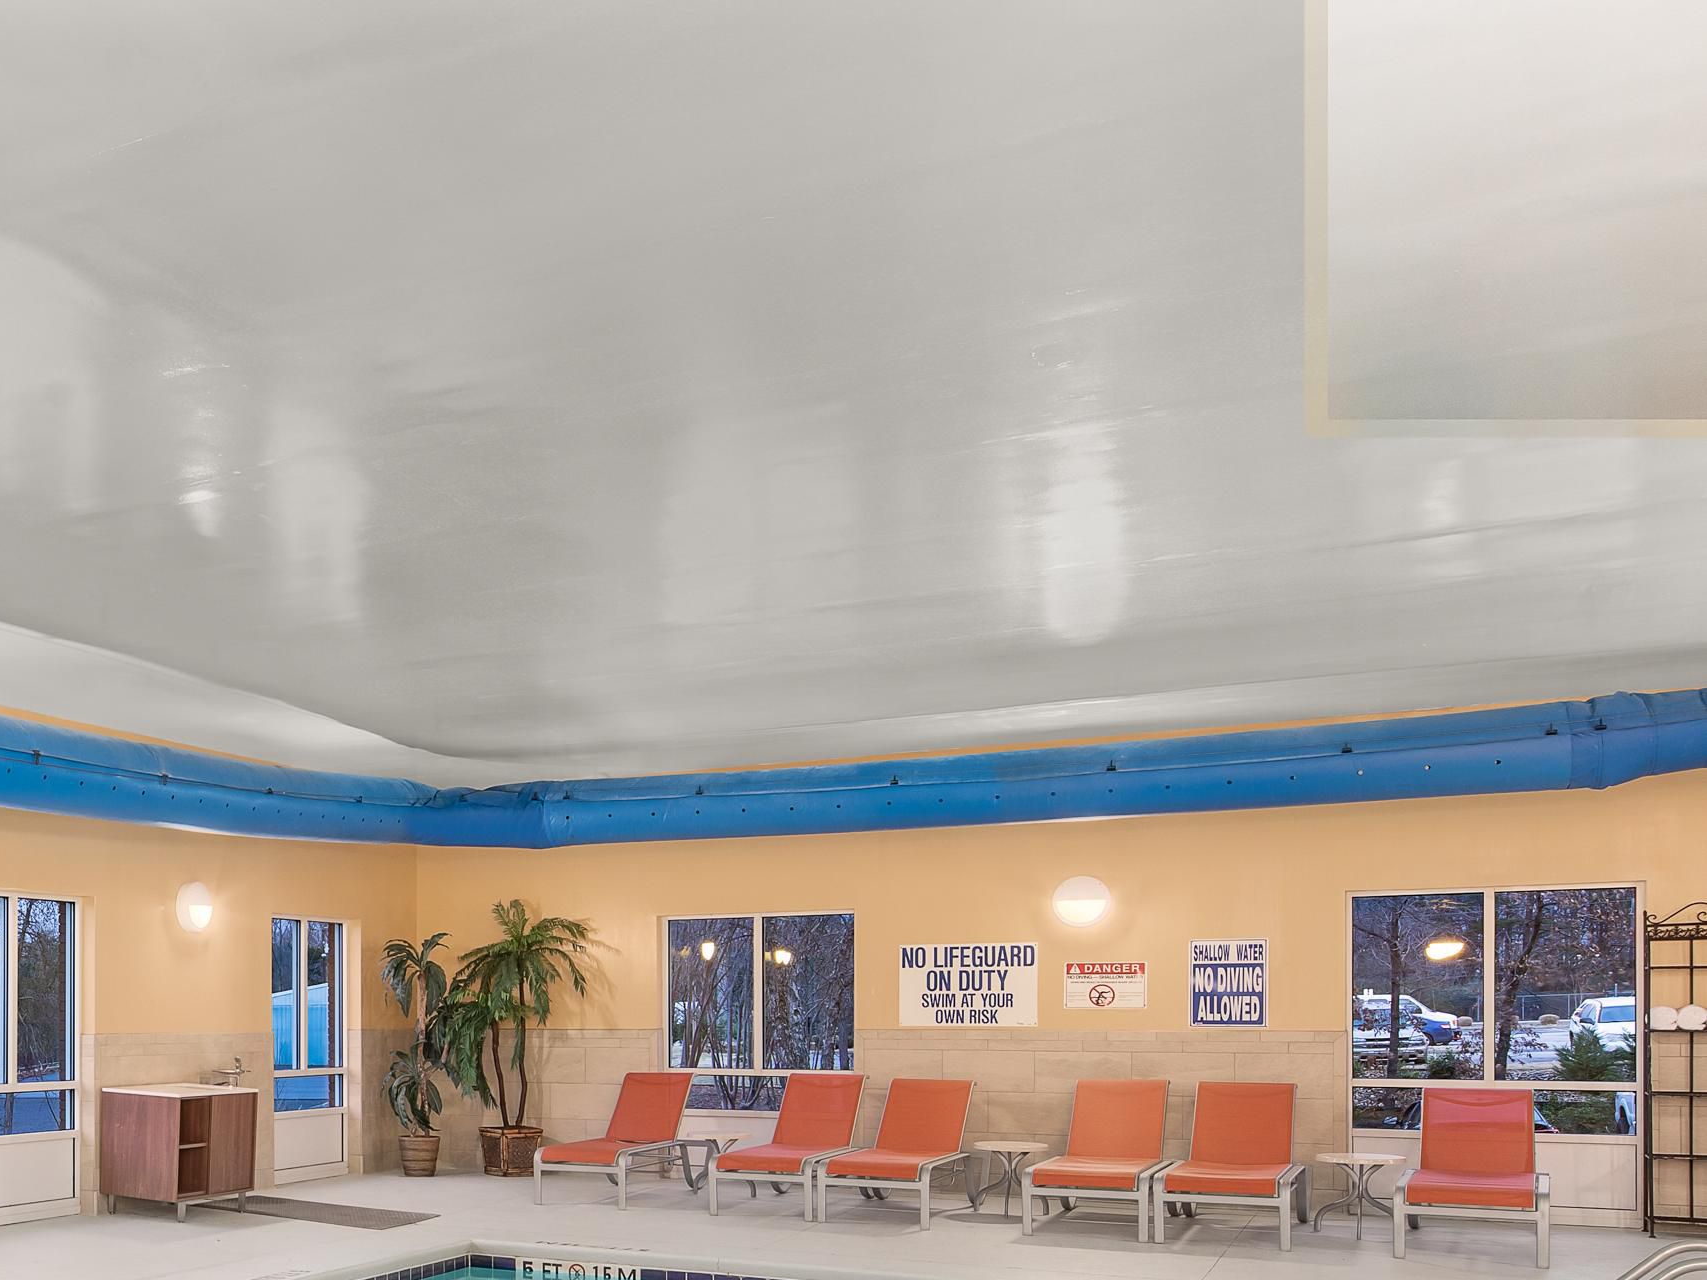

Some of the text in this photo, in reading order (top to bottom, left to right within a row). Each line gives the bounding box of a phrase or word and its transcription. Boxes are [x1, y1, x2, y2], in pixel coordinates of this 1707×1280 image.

[901, 945, 1035, 969] NO LIFEGUARD
[1194, 944, 1264, 961] SHALLOW WATER
[1084, 964, 1140, 973] DANGER
[926, 970, 1008, 991] ON DUTY
[1195, 967, 1263, 993] NO DIVING
[921, 993, 1014, 1008] SWIM AT YOUR
[1197, 995, 1260, 1022] ALLOWED
[935, 1009, 998, 1024] OWN RISK
